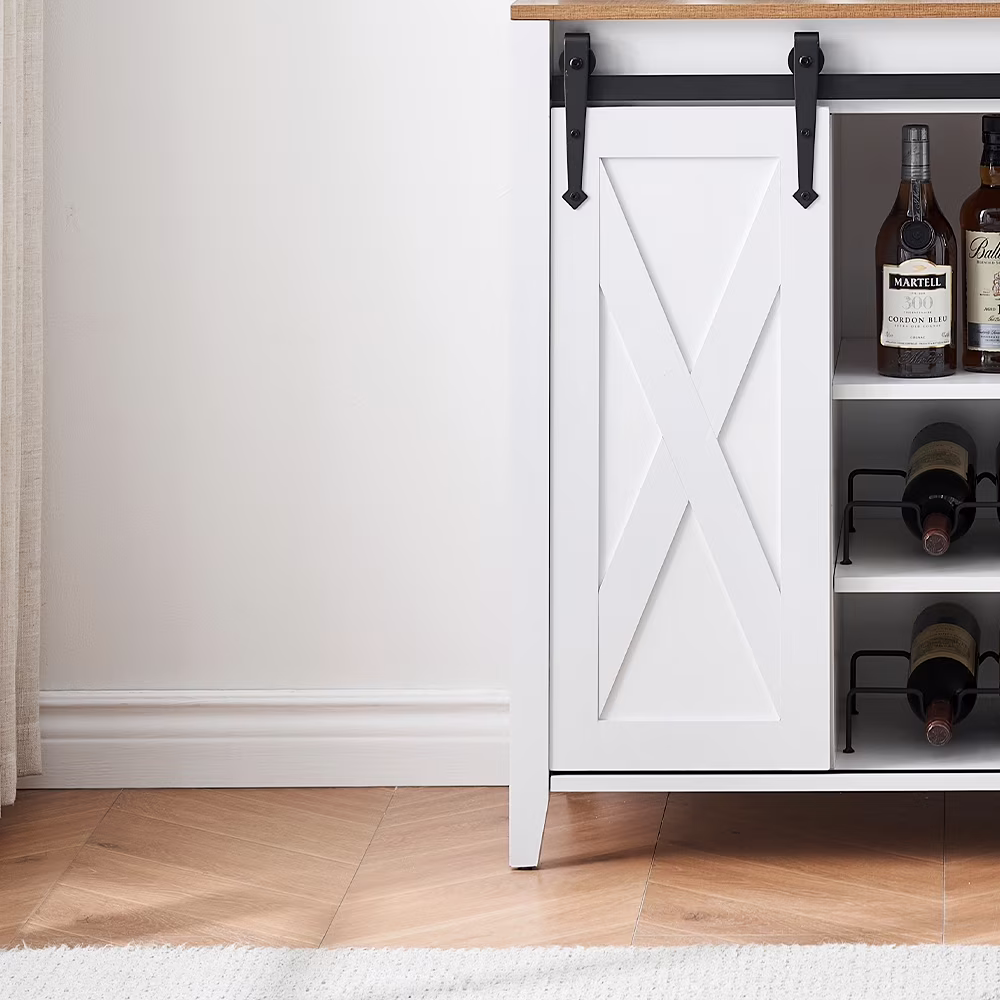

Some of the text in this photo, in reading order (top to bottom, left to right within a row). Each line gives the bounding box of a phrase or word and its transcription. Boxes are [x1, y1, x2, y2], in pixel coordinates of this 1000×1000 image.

[894, 277, 941, 287] MARTELL
[901, 295, 933, 310] 300
[888, 315, 948, 324] CORDON BLEU
